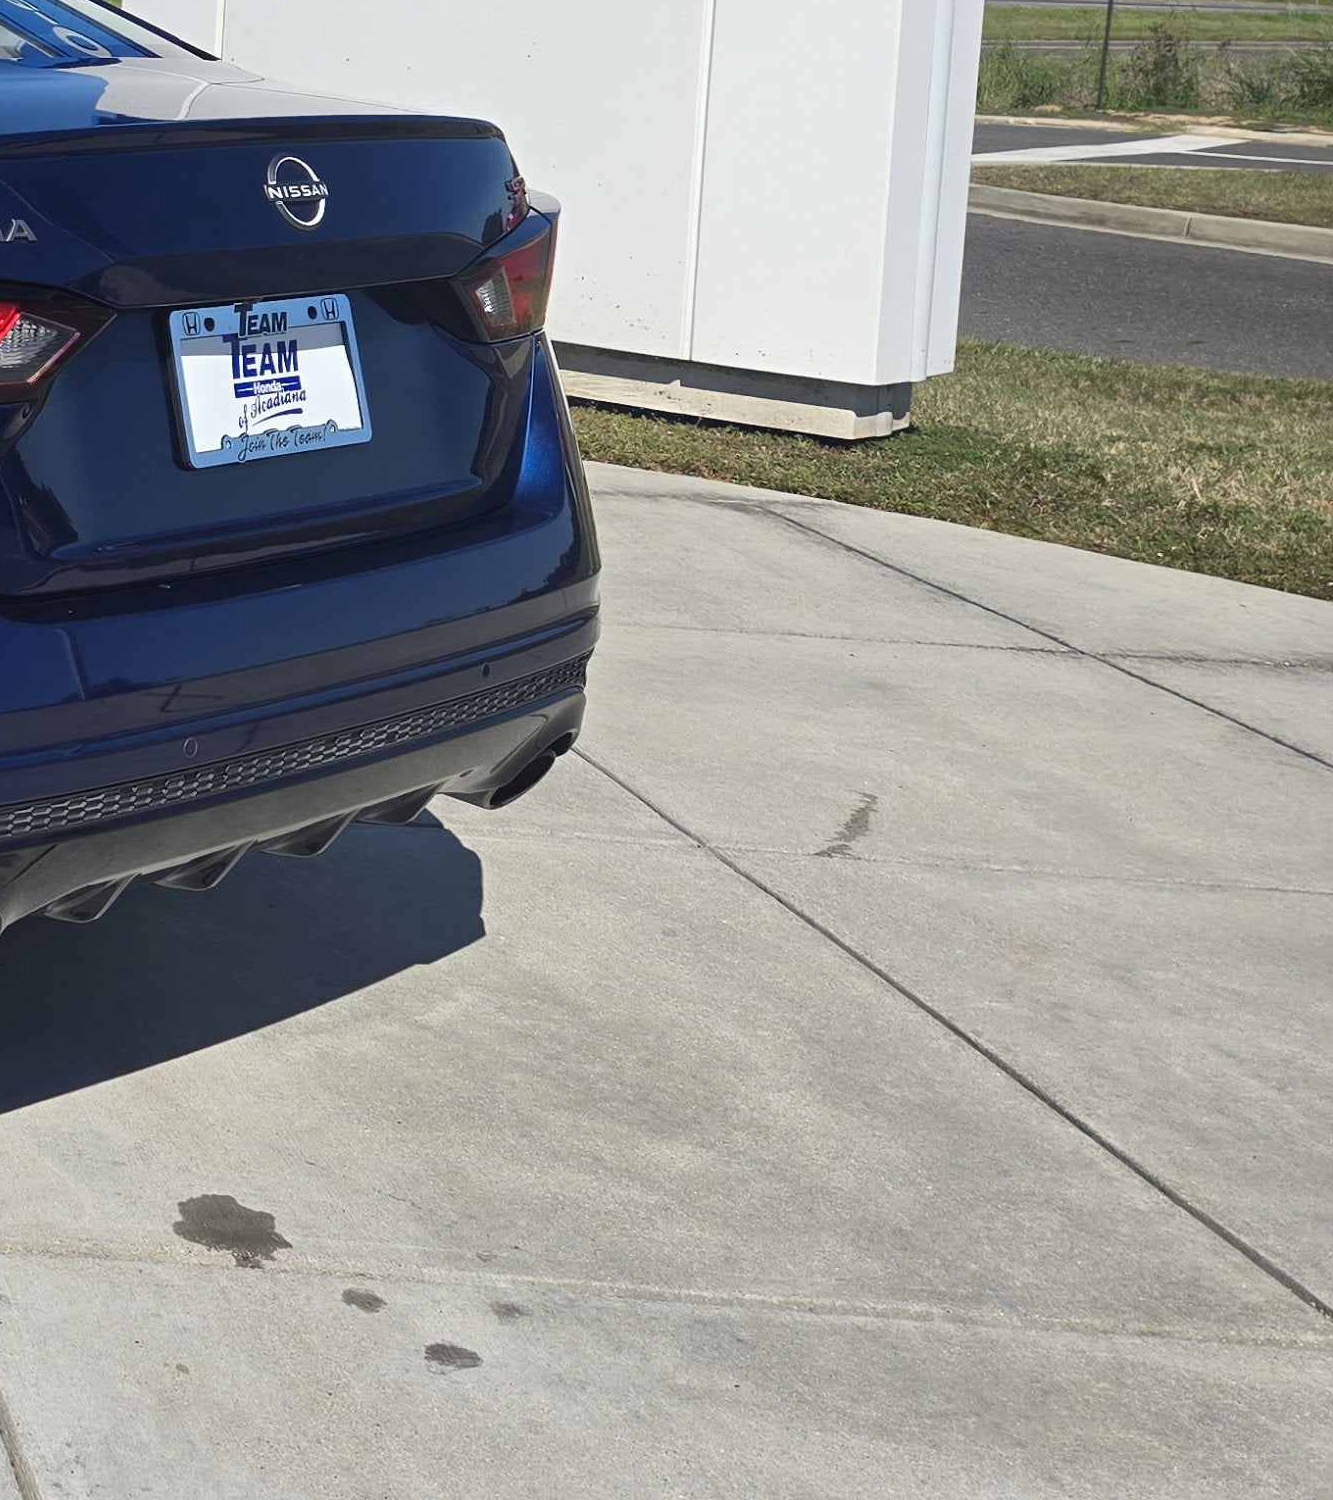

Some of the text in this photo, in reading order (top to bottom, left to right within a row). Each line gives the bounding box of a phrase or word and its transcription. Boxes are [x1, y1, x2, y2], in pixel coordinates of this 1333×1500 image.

[266, 183, 329, 199] NISSAN
[223, 334, 299, 379] TEAM
[253, 380, 283, 395] Honda
[238, 389, 307, 433] of Acadiana
[237, 433, 266, 461] Join
[266, 431, 289, 448] The
